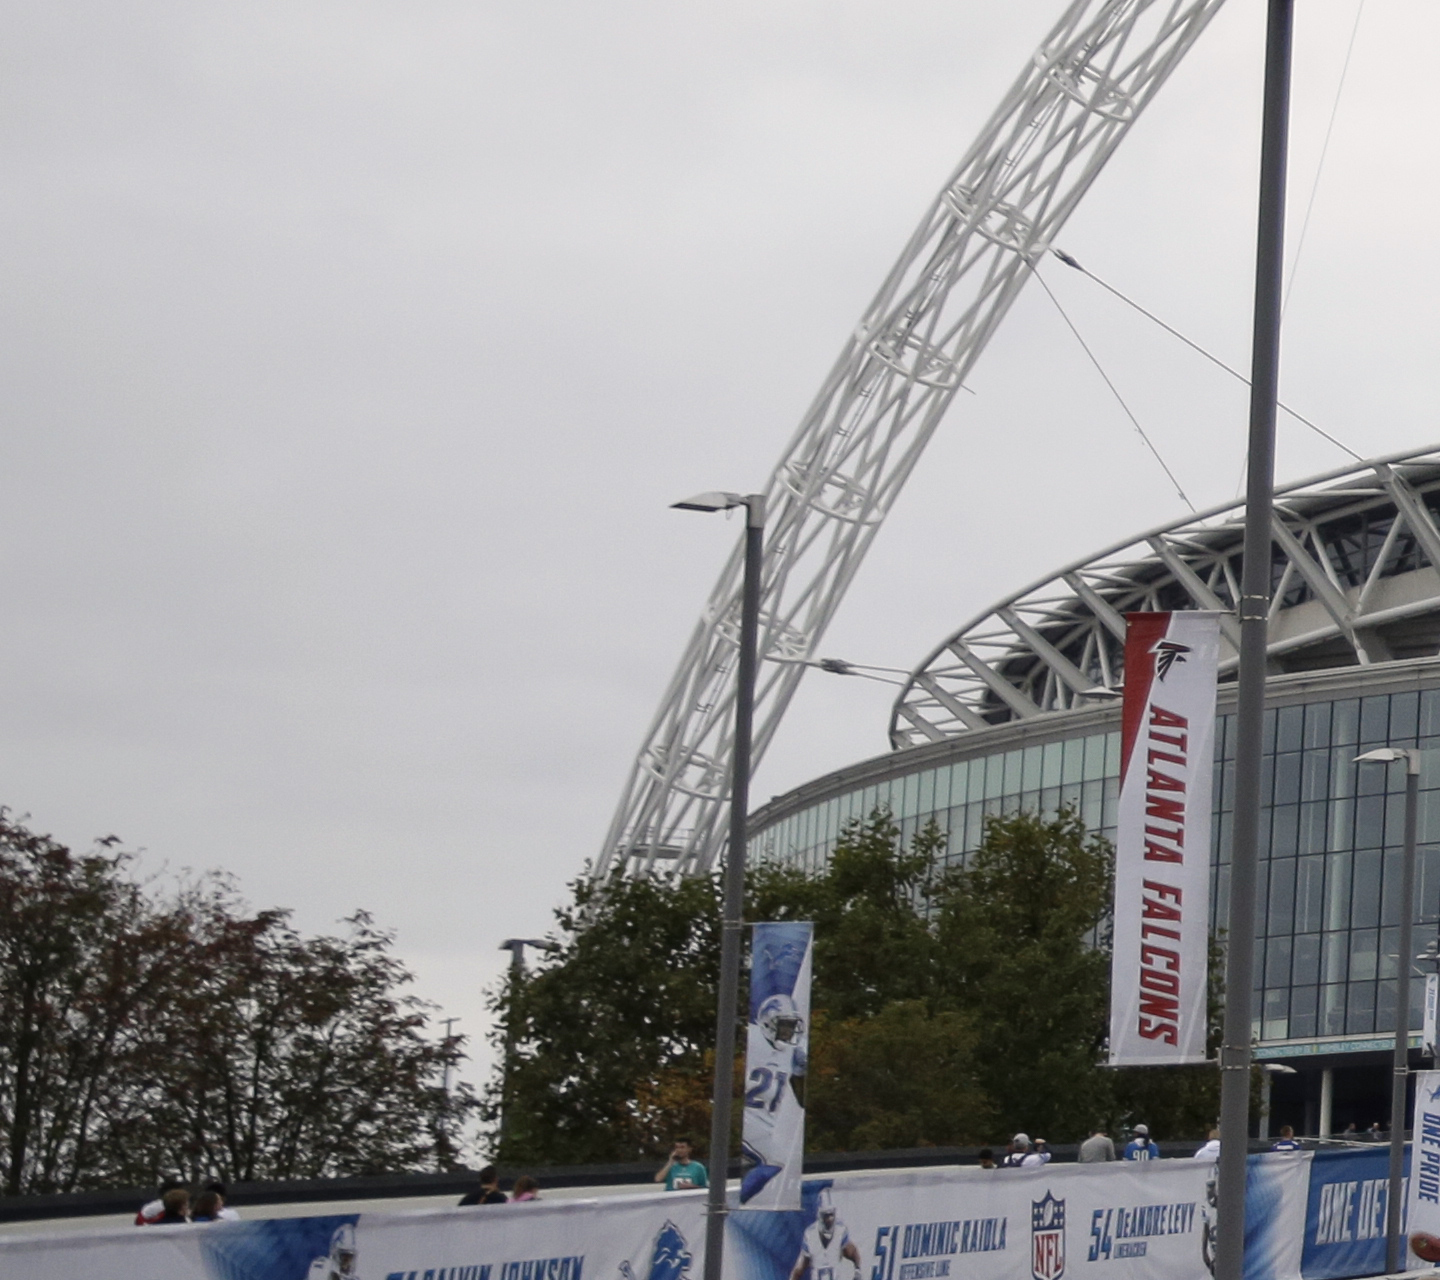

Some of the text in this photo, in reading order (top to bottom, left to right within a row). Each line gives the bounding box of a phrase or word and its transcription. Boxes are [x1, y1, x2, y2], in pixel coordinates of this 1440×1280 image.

[1137, 701, 1190, 1049] ATLANTA FALCONS
[902, 1217, 1008, 1260] DOMINIC RAIOLA
[1088, 1208, 1115, 1263] 54
[1168, 1202, 1196, 1235] LEVY
[1315, 1181, 1358, 1246] ONE
[1034, 1232, 1063, 1280] NFL
